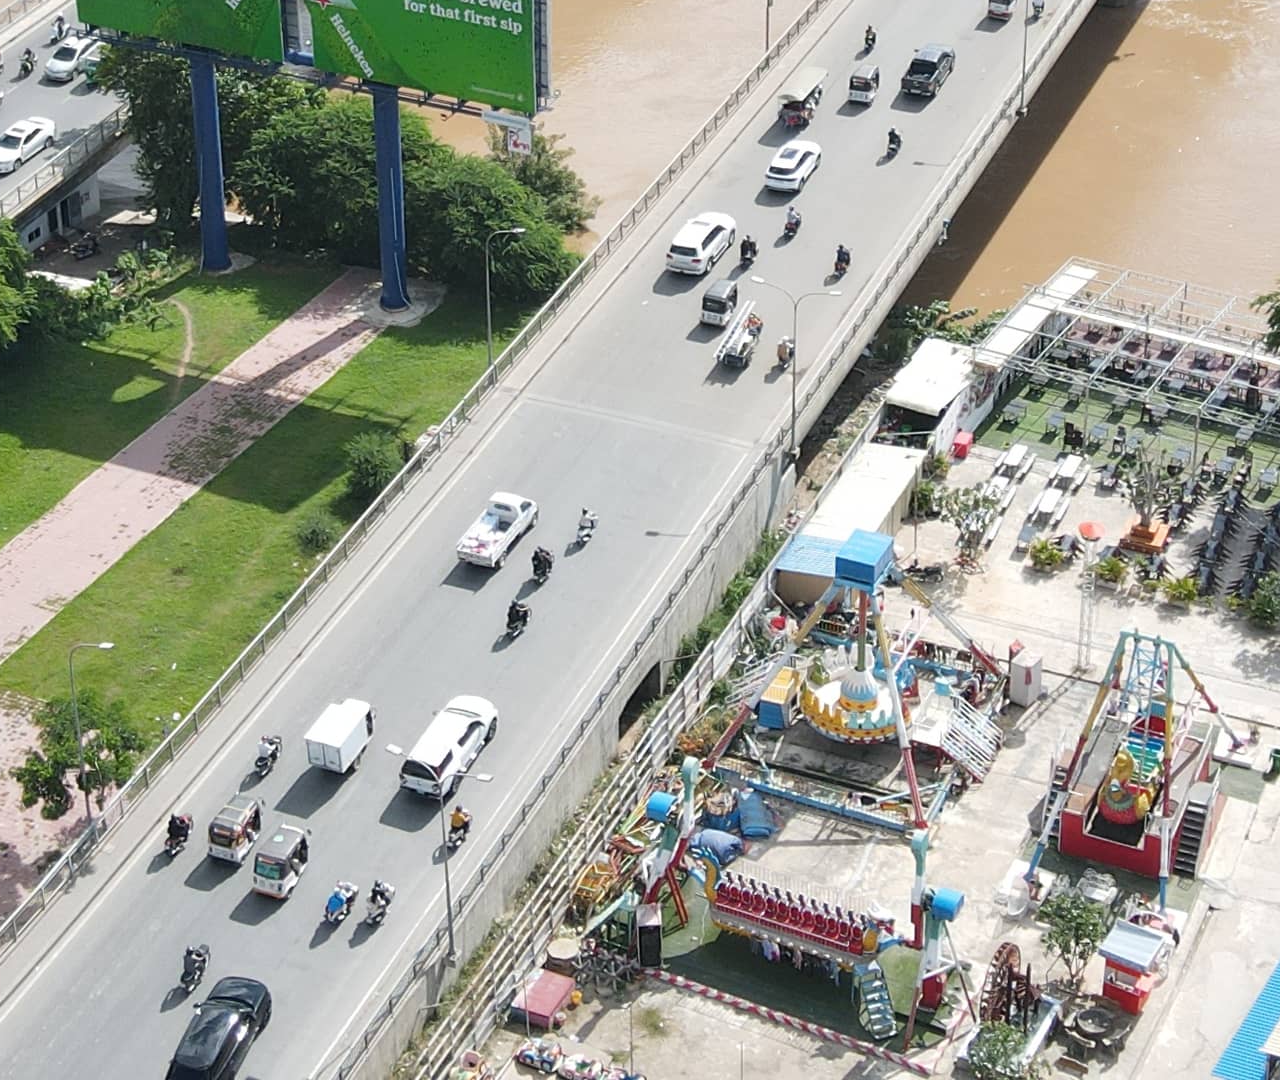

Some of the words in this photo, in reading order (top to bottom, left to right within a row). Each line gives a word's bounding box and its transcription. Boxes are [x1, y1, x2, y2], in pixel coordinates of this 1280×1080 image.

[429, 2, 460, 21] that
[463, 10, 497, 29] first
[500, 17, 523, 35] sip
[330, 12, 375, 78] Heineken
